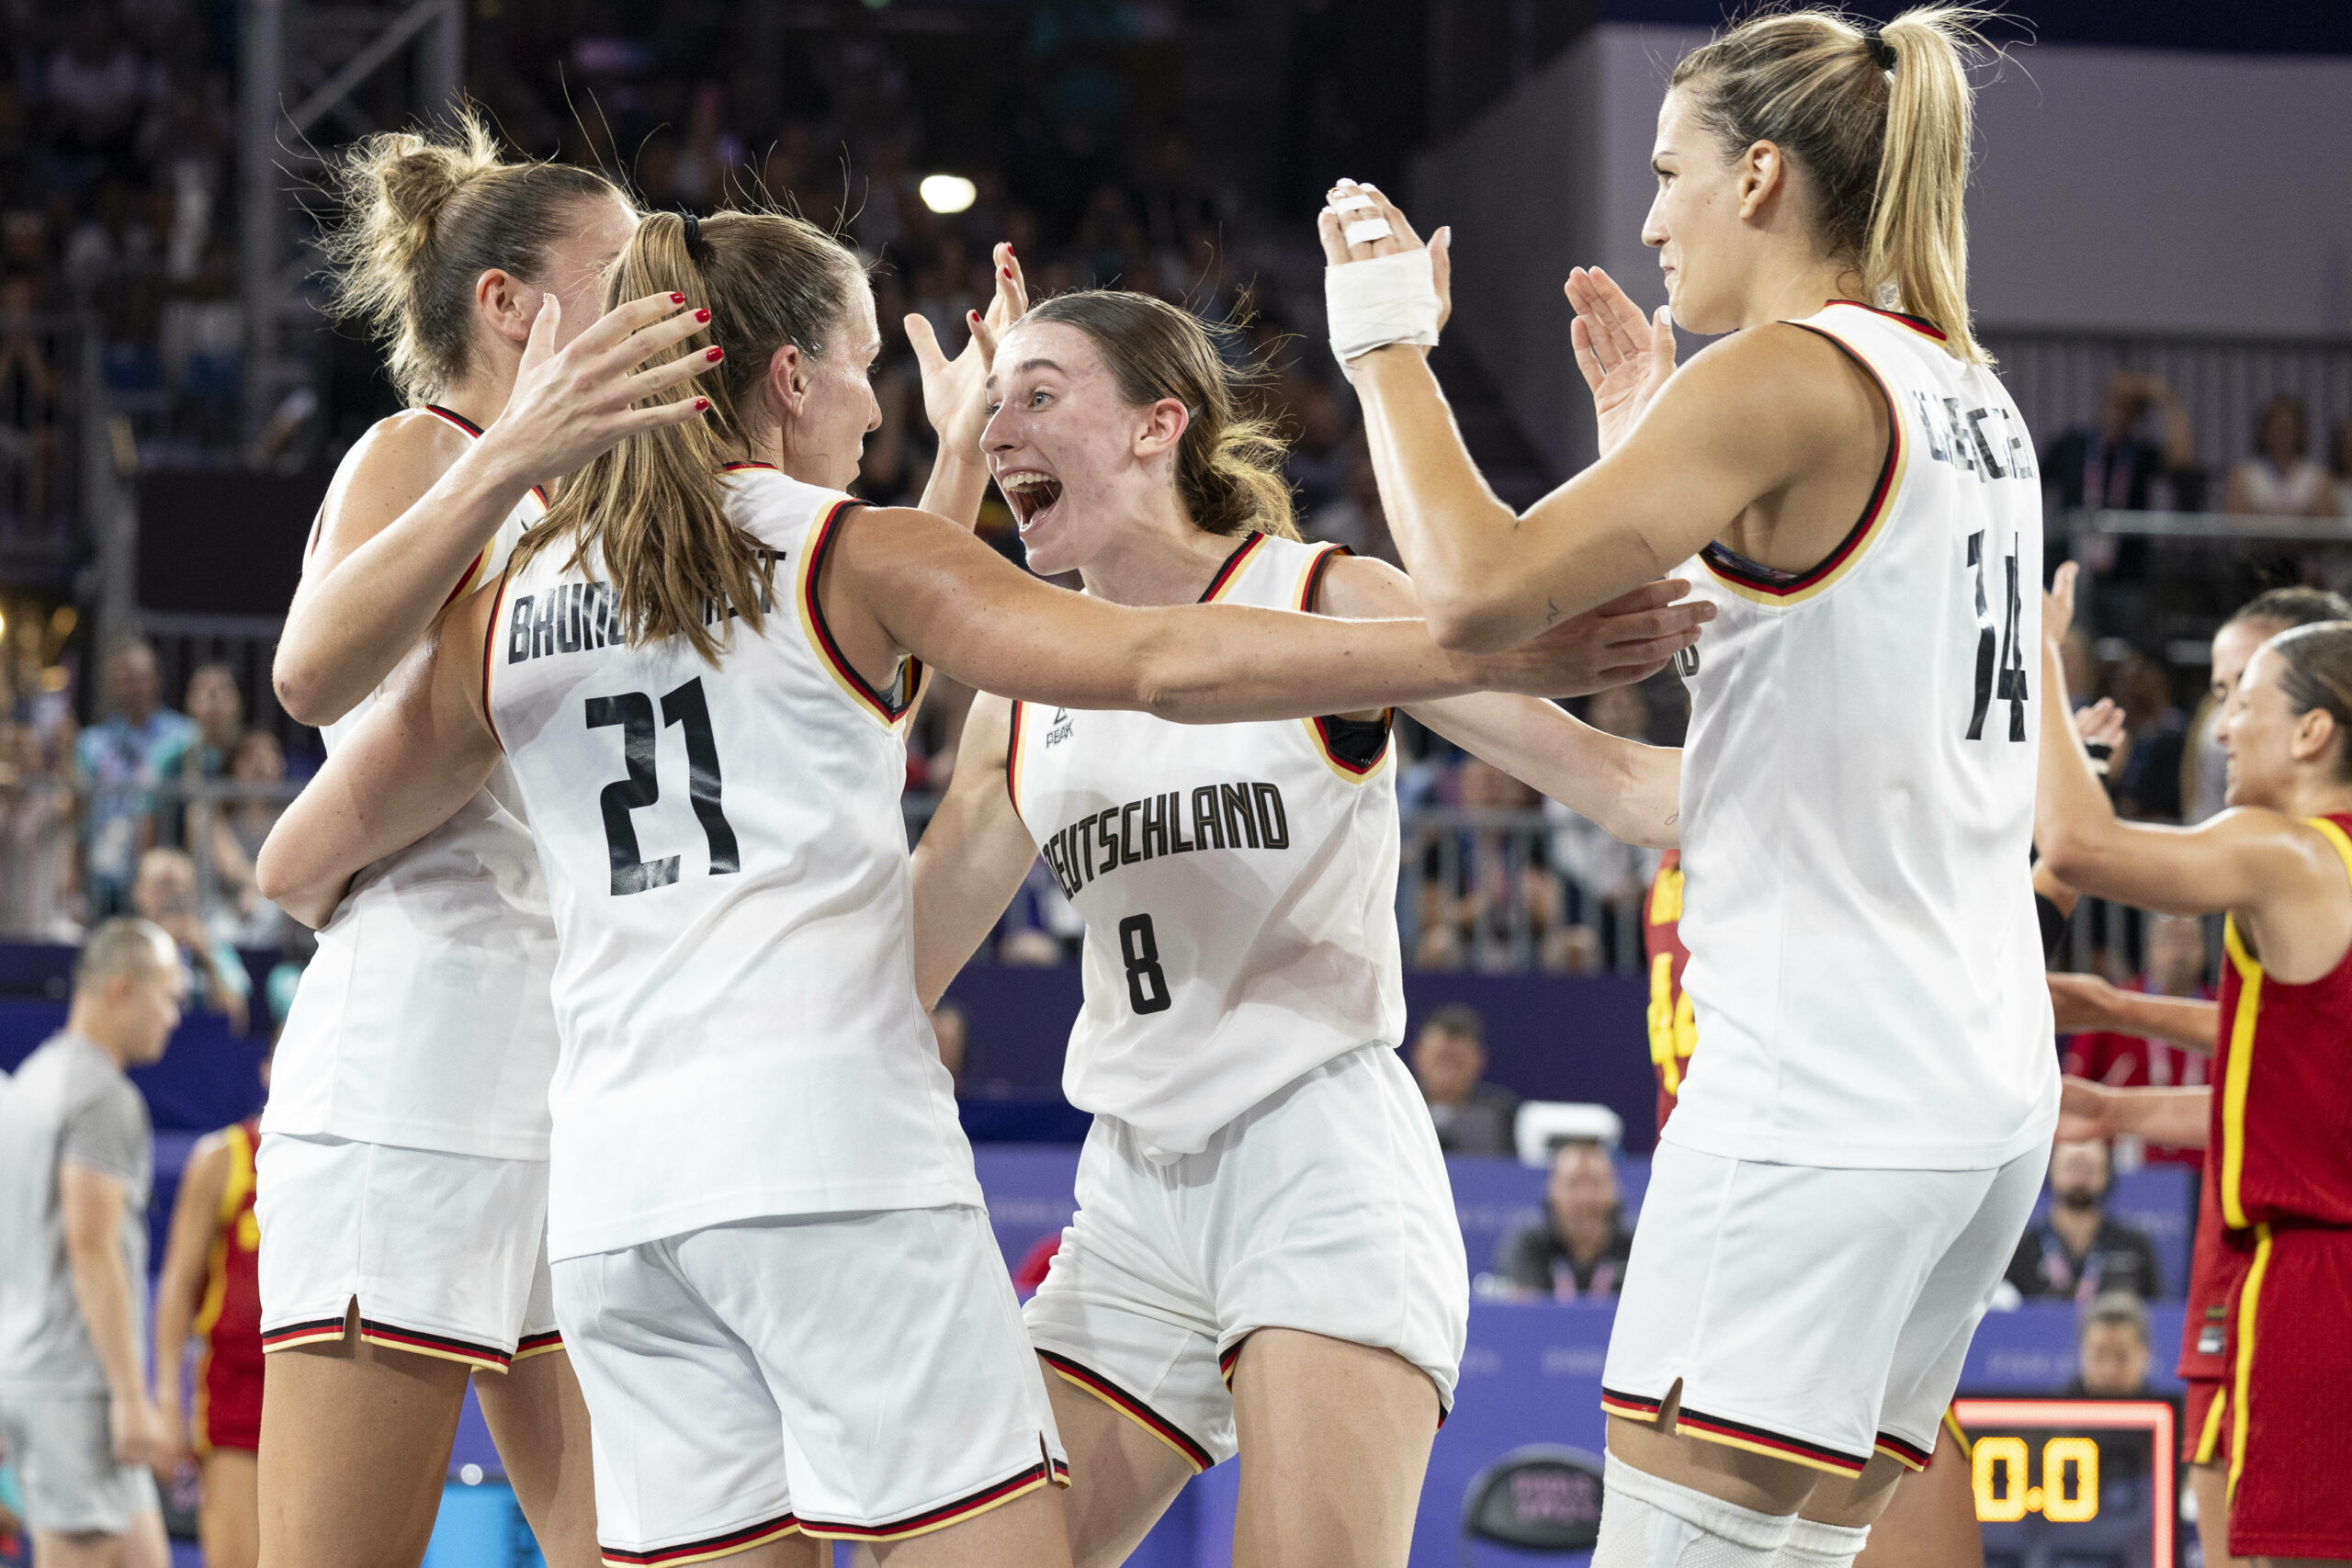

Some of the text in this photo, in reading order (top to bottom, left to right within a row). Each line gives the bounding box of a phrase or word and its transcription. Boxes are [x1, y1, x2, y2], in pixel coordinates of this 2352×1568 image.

[1964, 528, 2030, 743] 14
[584, 675, 741, 897] 21
[1046, 718, 1075, 750] PEAK
[1042, 782, 1290, 901] DEUTSCHLAND
[1118, 912, 1172, 1016] 8
[1971, 1436, 2100, 1523] 0.0
